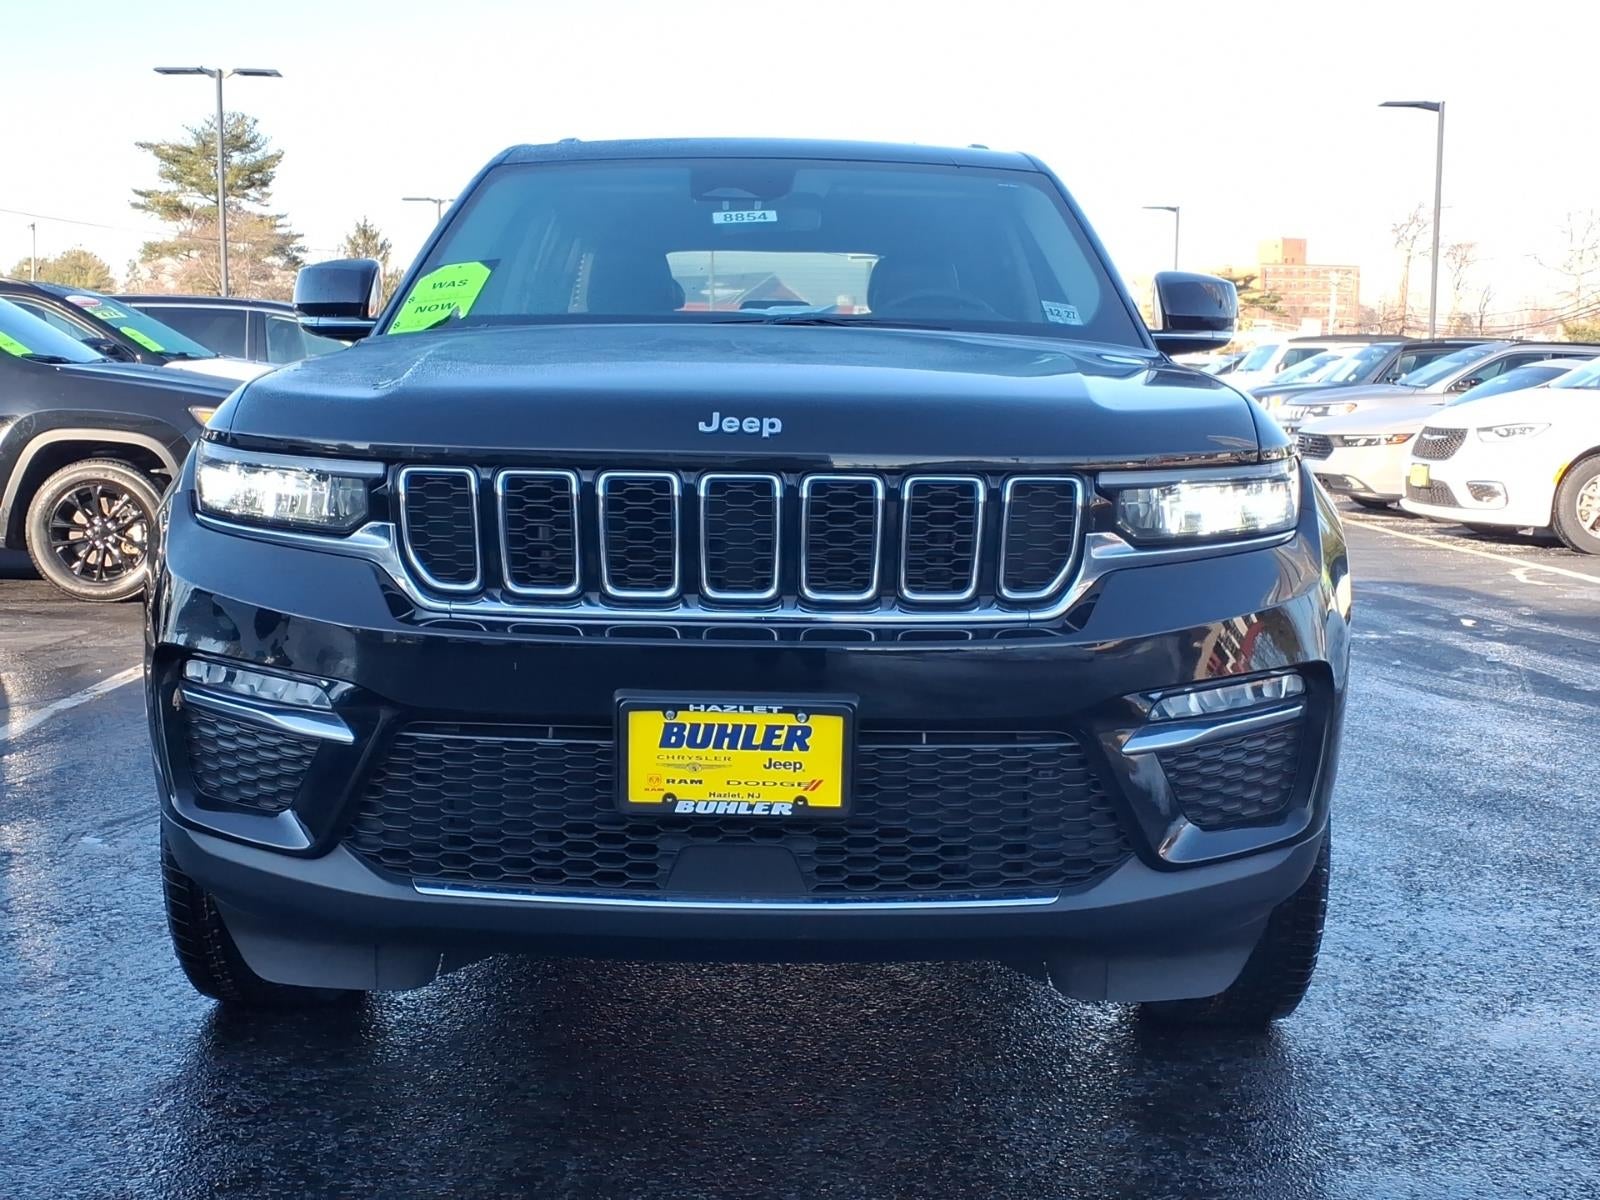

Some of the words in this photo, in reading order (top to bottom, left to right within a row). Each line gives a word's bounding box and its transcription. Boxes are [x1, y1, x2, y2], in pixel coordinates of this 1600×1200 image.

[723, 212, 768, 222] 8854
[432, 279, 469, 290] WAS
[414, 302, 457, 314] NOW
[698, 411, 782, 438] Jeep
[689, 704, 783, 714] HAZLET
[659, 722, 813, 752] BUHLER
[763, 757, 803, 773] Jeep
[726, 780, 810, 788] DODGE
[747, 792, 761, 800] NJ
[674, 800, 793, 816] BUHLER
